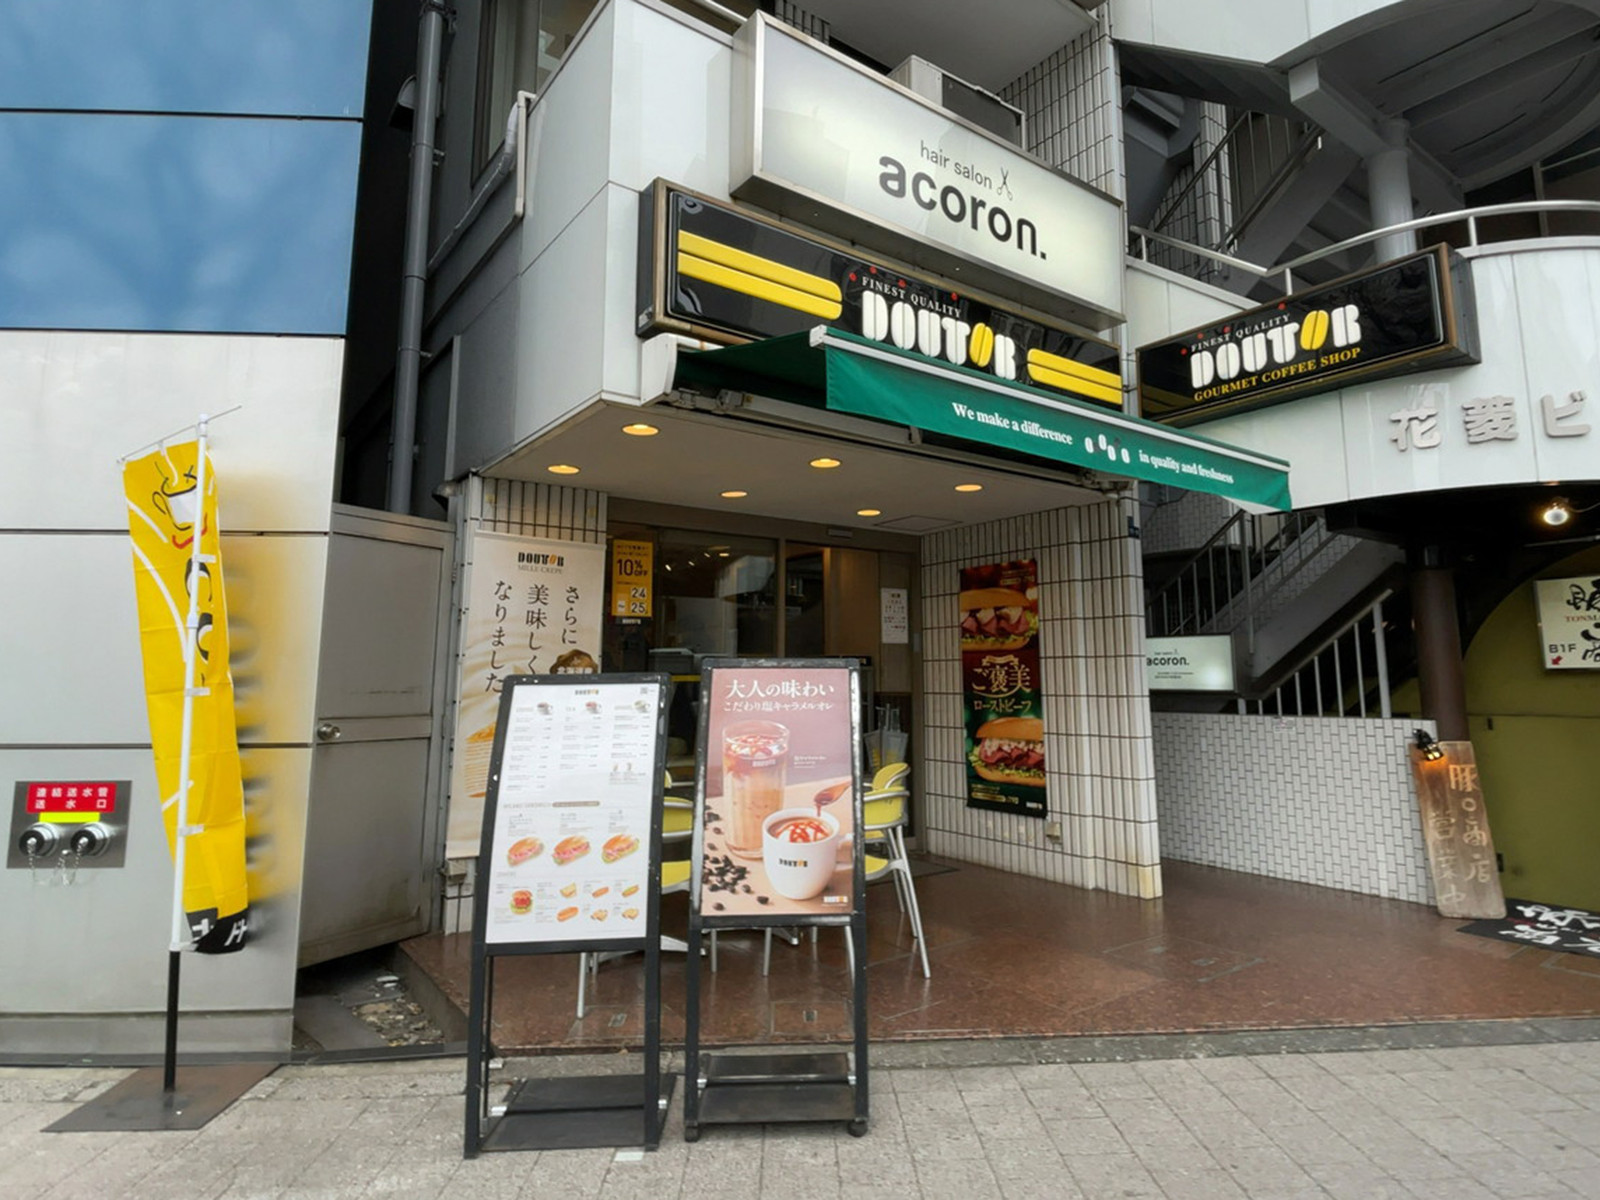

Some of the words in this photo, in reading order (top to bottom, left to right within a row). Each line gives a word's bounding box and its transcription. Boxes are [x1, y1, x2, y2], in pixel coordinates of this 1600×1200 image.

[920, 140, 951, 169] hair
[953, 161, 993, 190] salon
[878, 155, 1047, 260] acoron.
[862, 276, 906, 300] FINEST
[910, 293, 962, 319] QUALITY
[862, 290, 1017, 381] DOUTOR
[1190, 304, 1362, 389] DOUTOR
[1191, 332, 1232, 353] FINEST
[1235, 313, 1291, 338] QUALITY
[1194, 376, 1260, 402] GOURMET
[1261, 359, 1318, 384] COFFEE
[1320, 347, 1361, 368] SHOP
[951, 402, 975, 420] We
[976, 411, 1010, 430] make
[1011, 420, 1020, 432] a
[1020, 420, 1073, 446] difference
[1389, 391, 1592, 452] 花菱ビ
[1138, 449, 1150, 464] in
[1150, 456, 1180, 473] quality
[1181, 462, 1198, 475] and
[1198, 464, 1234, 484] freshness
[517, 551, 565, 567] DOUTOR
[616, 558, 635, 577] 10
[484, 580, 513, 694] なりました
[525, 583, 550, 675] 美味しく
[561, 585, 580, 645] さらに
[1548, 643, 1577, 654] B1F
[725, 679, 835, 699] 大人の味わい
[973, 698, 1032, 713] ローストビーフ
